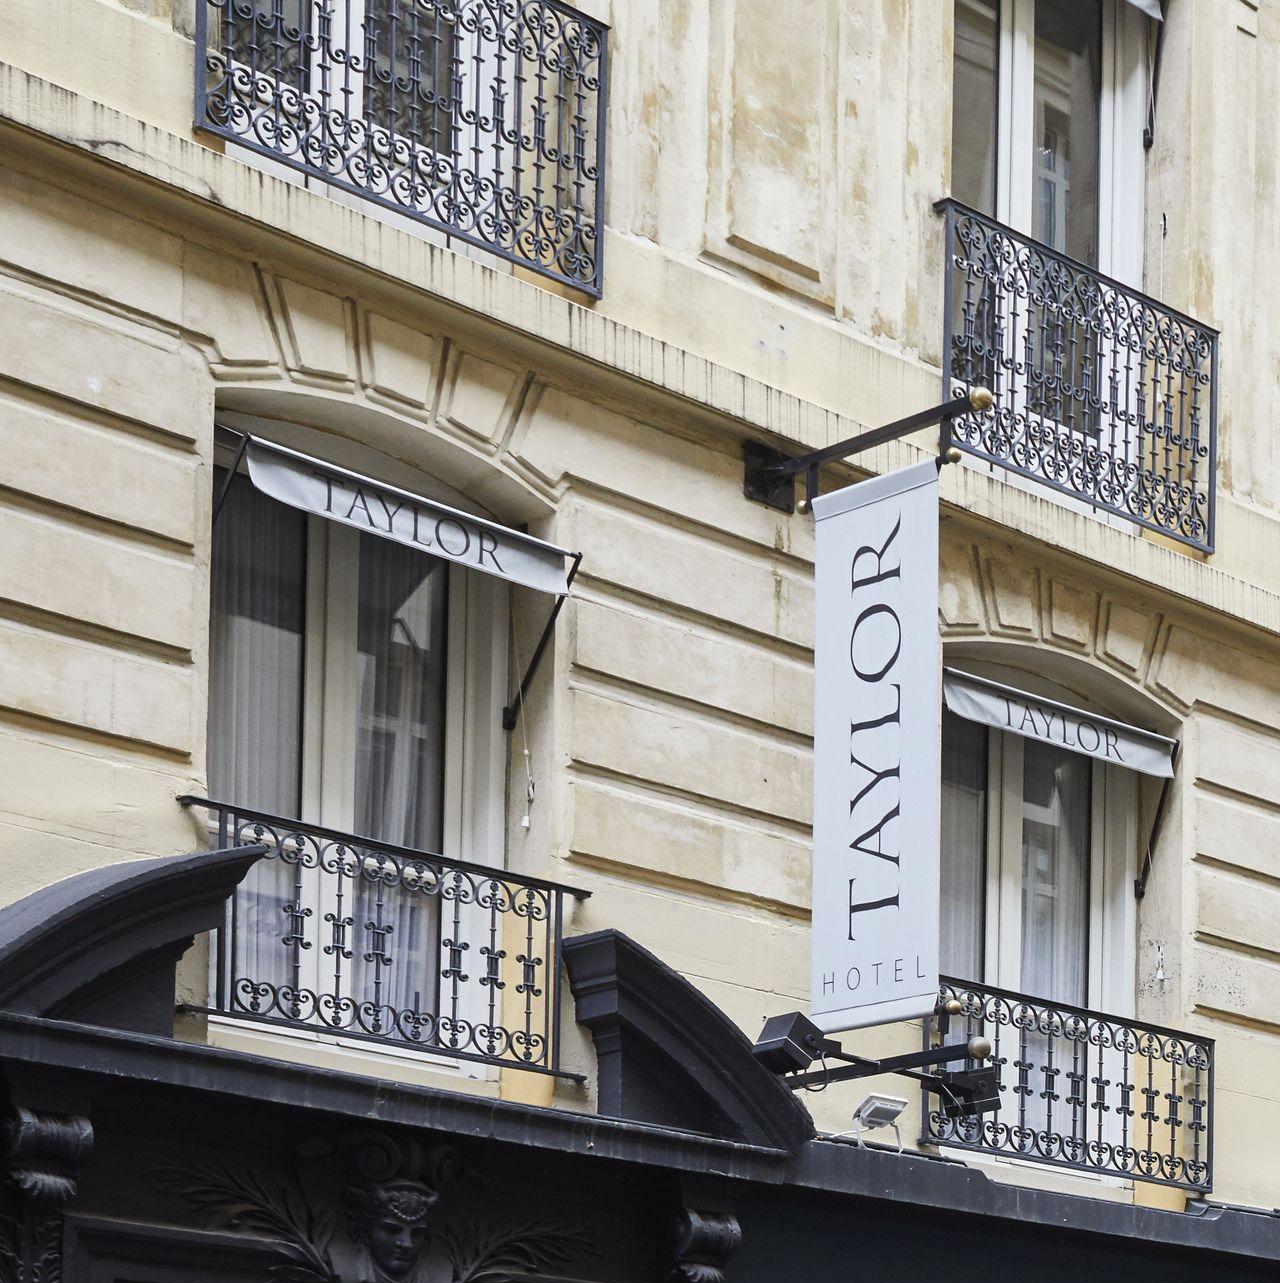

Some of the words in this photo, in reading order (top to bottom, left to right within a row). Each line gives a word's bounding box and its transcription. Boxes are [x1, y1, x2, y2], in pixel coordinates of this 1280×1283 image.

[313, 471, 507, 573] TAYLOR
[848, 508, 902, 942] TAYLOR
[997, 694, 1126, 762] TAYLOR
[823, 956, 926, 996] HOTEL
